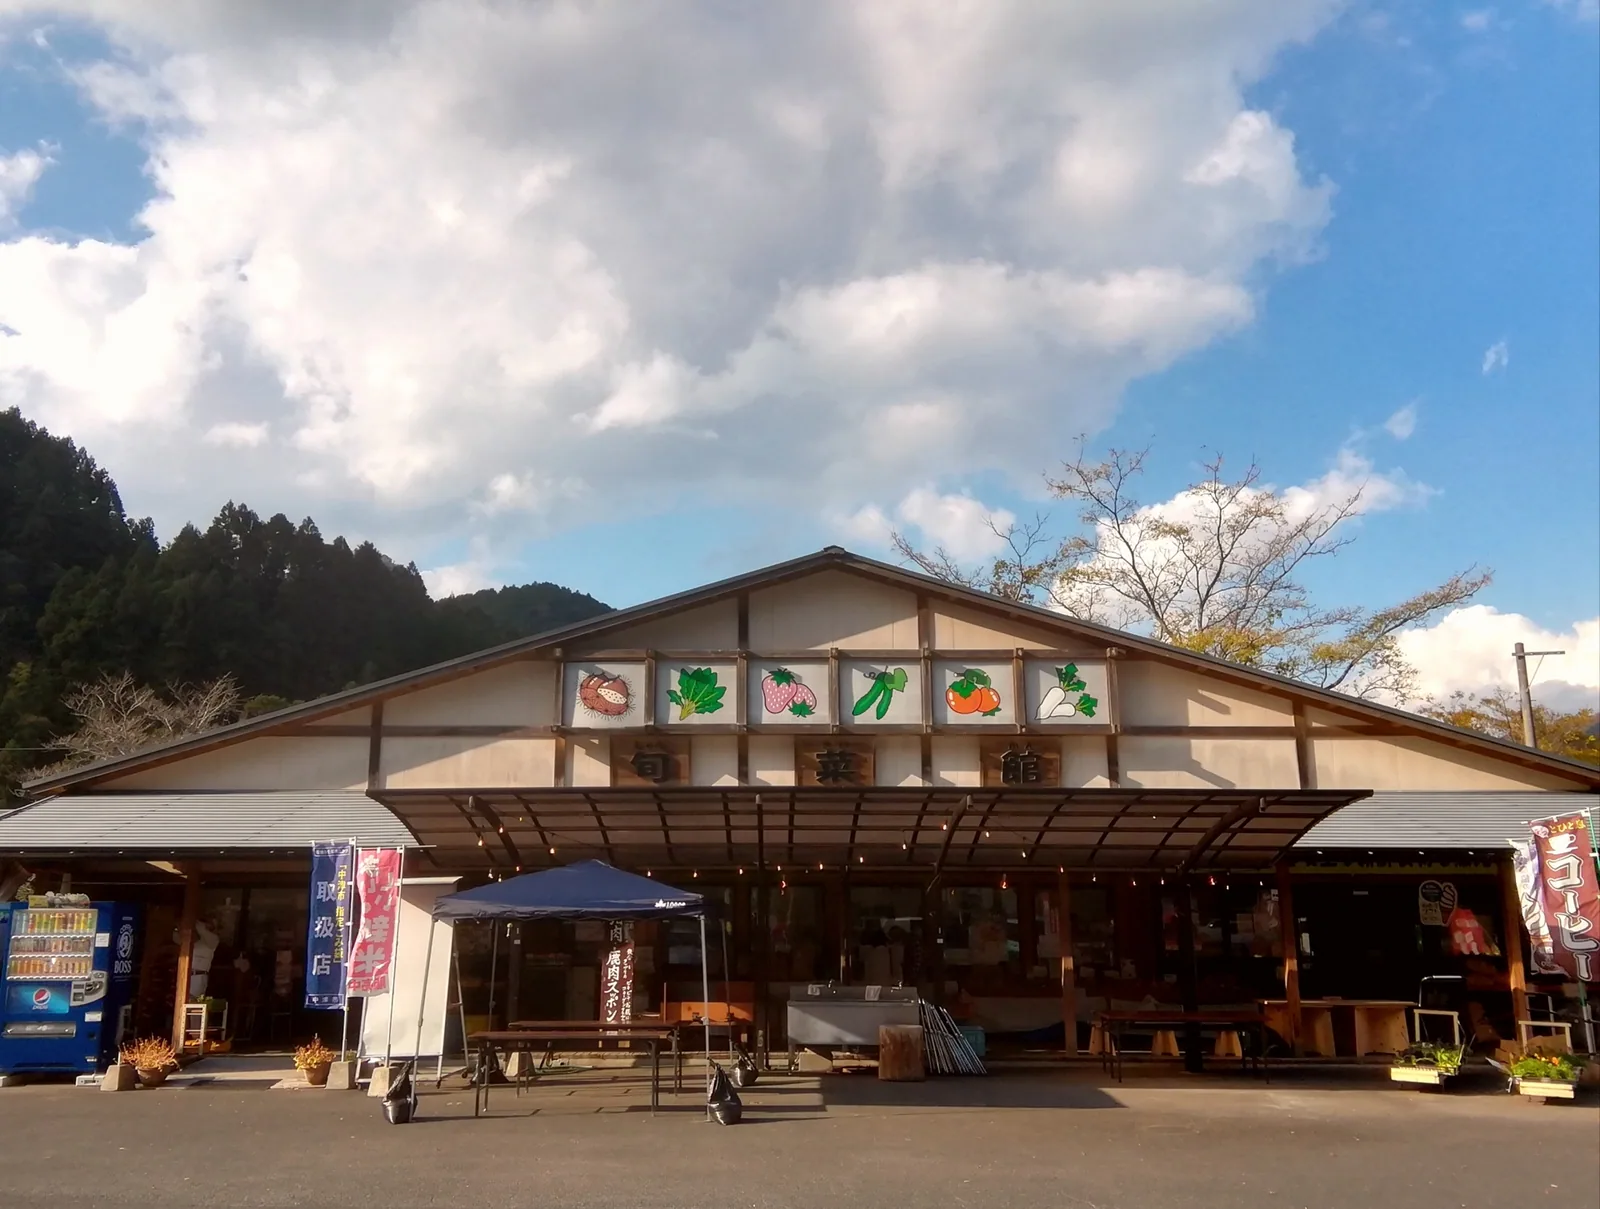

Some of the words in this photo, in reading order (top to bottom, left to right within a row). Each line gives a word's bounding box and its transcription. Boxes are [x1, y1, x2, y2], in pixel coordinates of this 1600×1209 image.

[312, 881, 337, 975] 取扱店
[1546, 854, 1599, 981] コーヒー
[113, 959, 133, 974] BOSS
